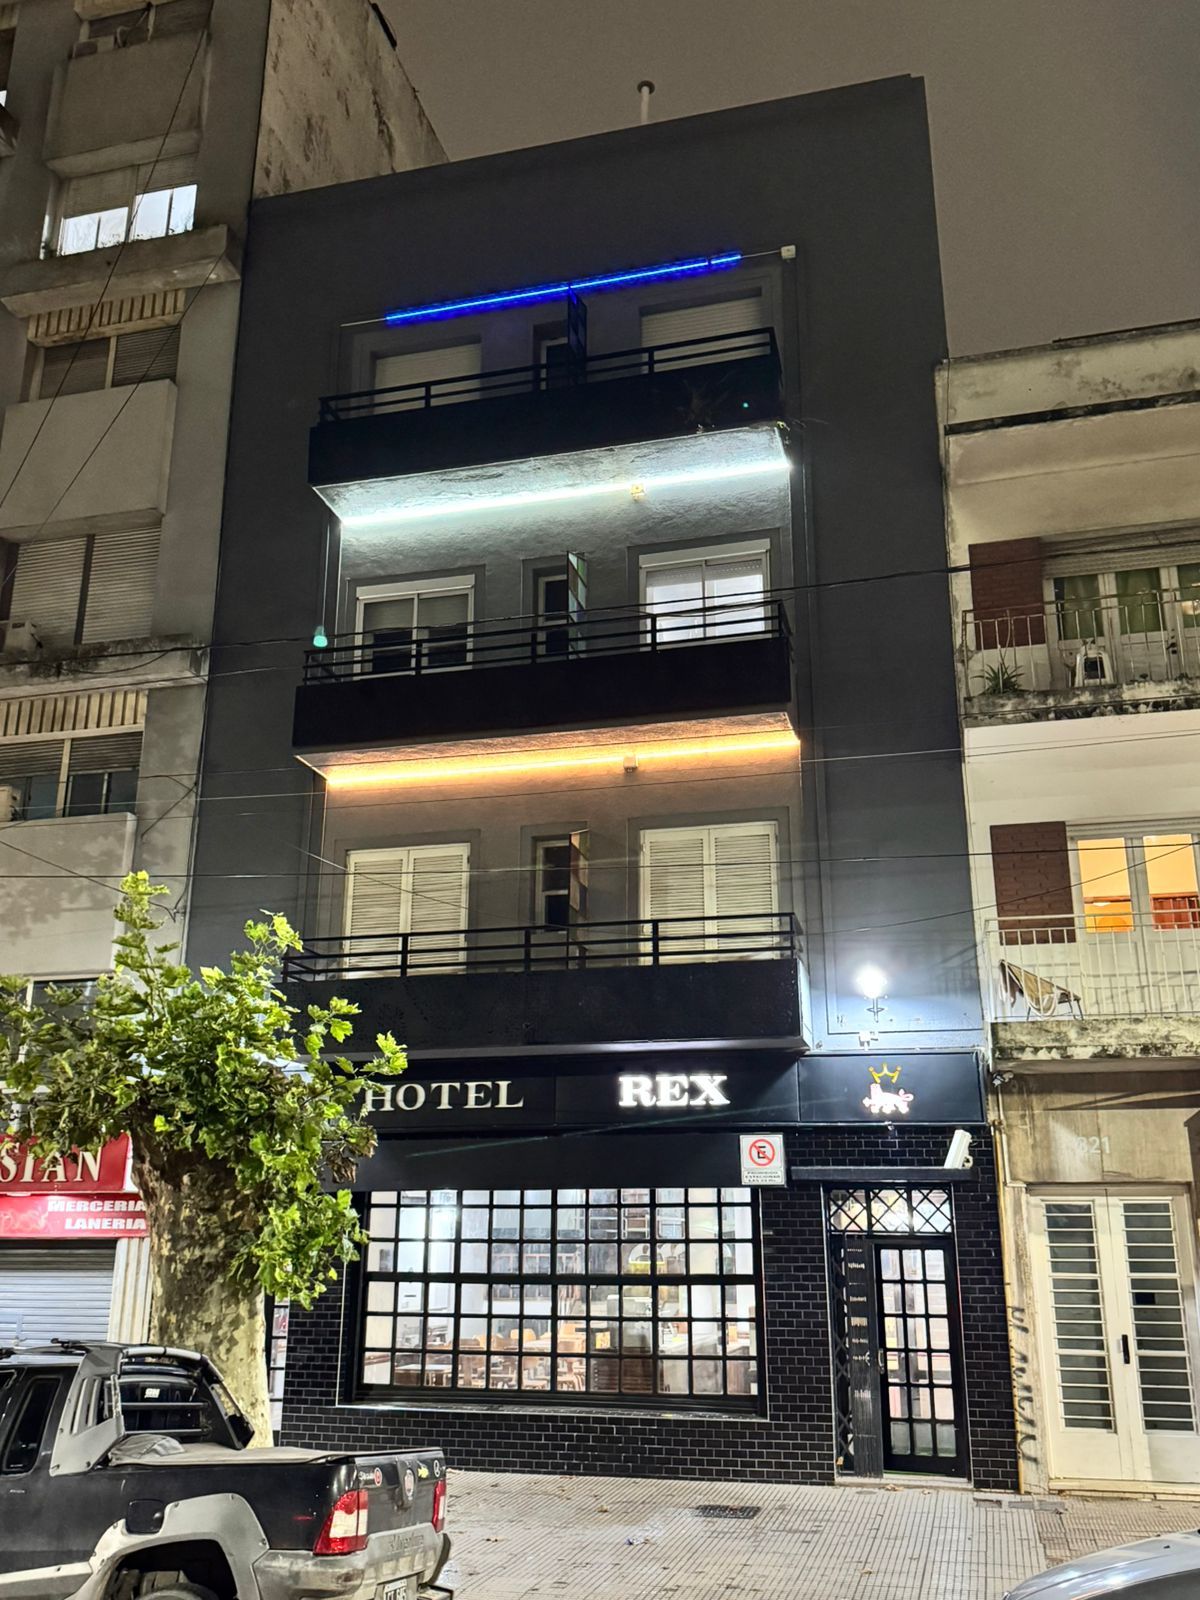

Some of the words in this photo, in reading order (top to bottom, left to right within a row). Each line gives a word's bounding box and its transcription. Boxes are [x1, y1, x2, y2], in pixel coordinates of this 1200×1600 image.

[364, 1081, 524, 1112] HOTEL
[618, 1073, 731, 1107] REX
[48, 1200, 146, 1212] MERCERIA
[64, 1218, 146, 1230] LANERIA
